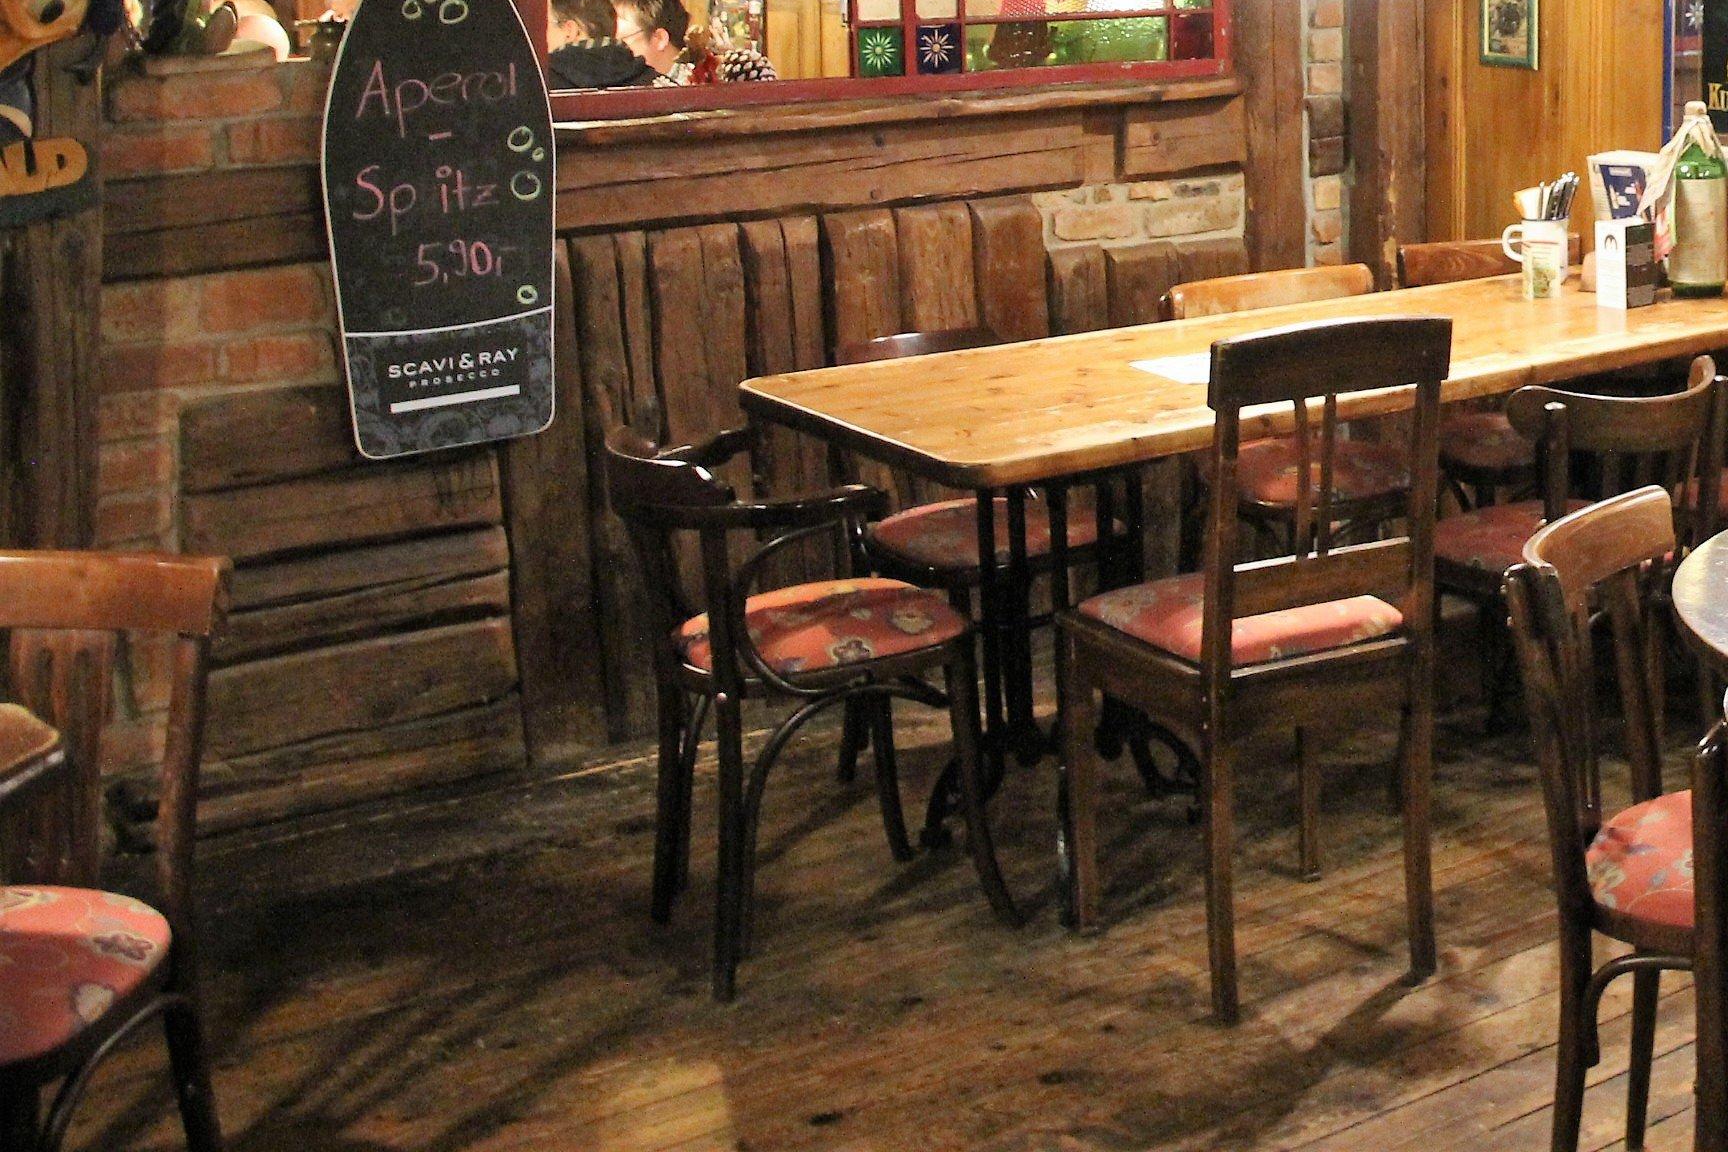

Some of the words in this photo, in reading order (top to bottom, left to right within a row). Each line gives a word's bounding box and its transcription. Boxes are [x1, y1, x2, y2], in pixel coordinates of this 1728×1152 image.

[355, 59, 518, 139] Aperol
[388, 357, 454, 379] SCAVI
[458, 352, 474, 370] &
[478, 348, 519, 366] RAY
